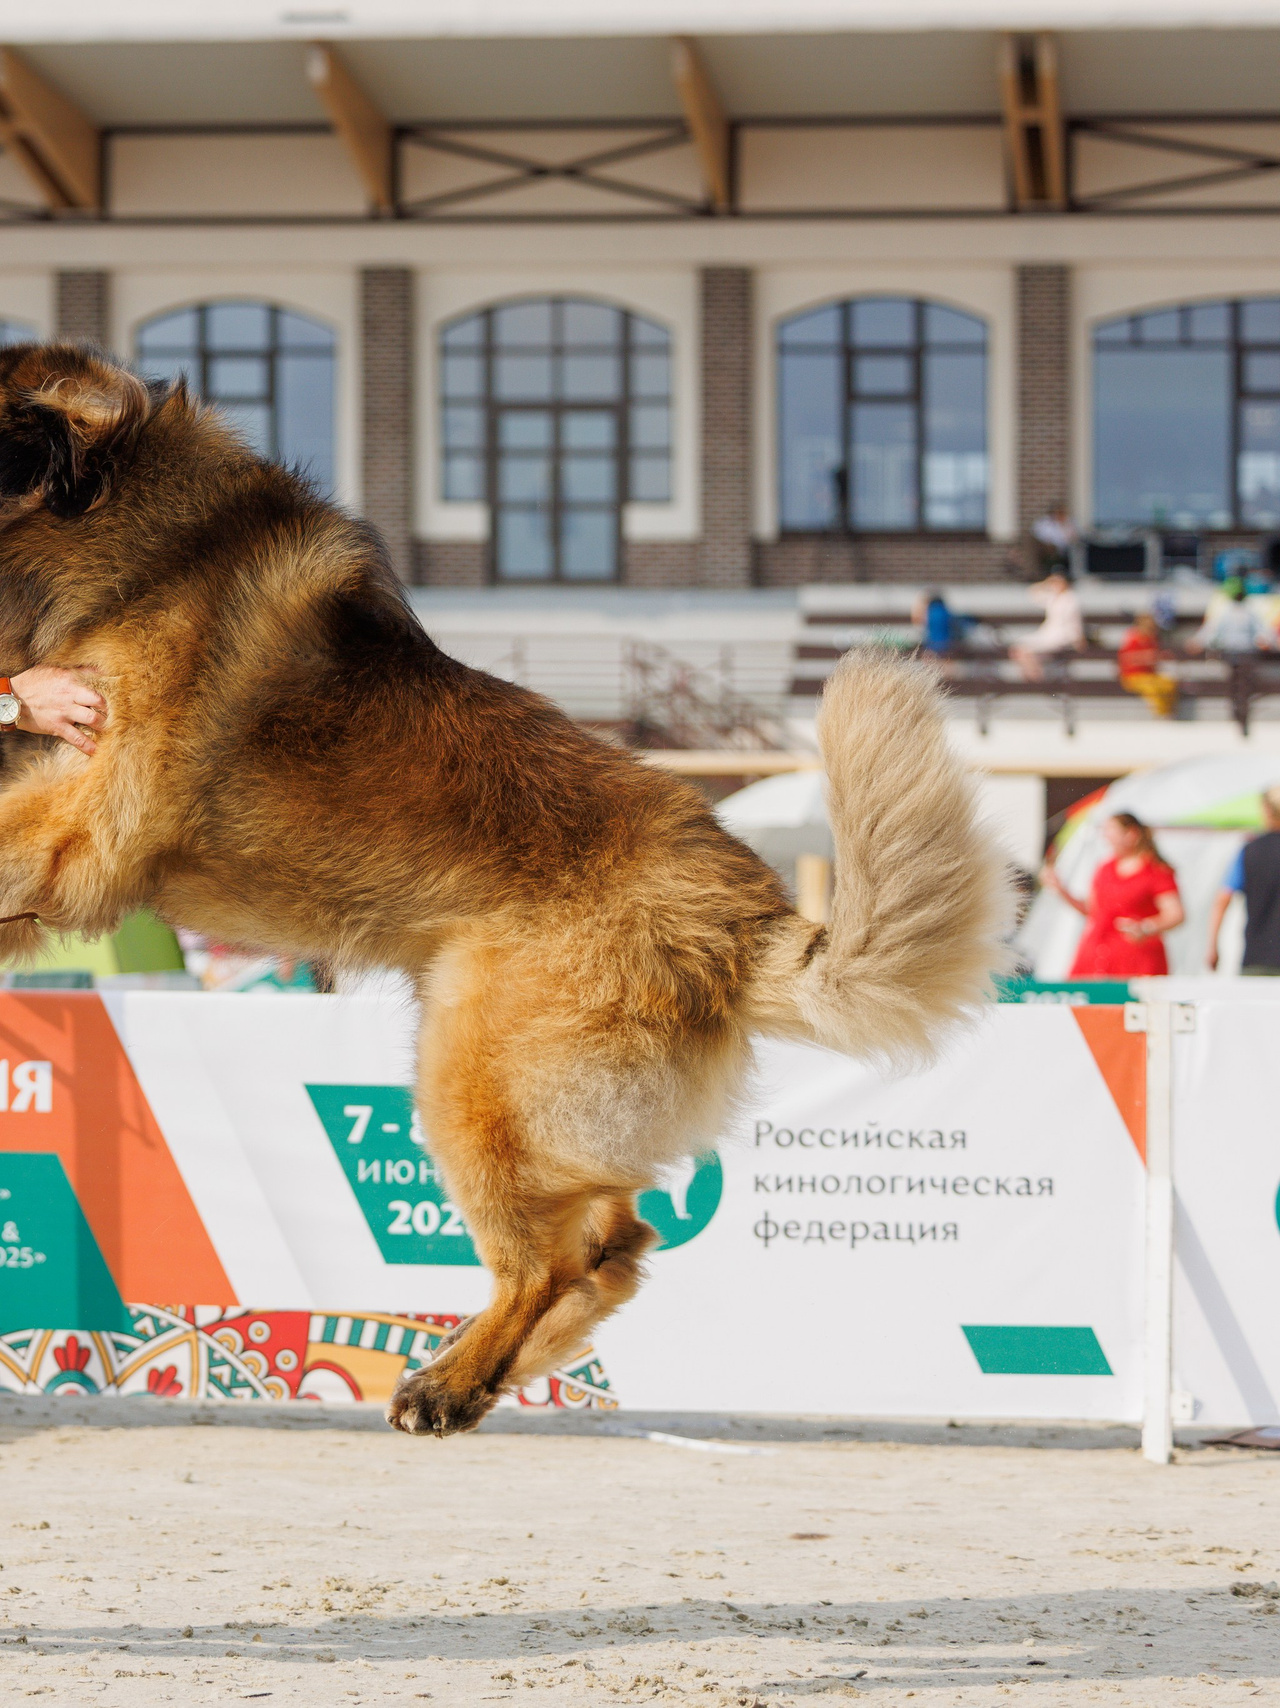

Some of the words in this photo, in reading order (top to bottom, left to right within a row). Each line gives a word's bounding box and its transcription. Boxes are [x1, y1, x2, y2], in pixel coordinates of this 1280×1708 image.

[754, 1119, 968, 1150] Российская
[357, 1158, 442, 1185] ИЮН
[753, 1173, 1056, 1196] кинологическая
[0, 1220, 21, 1243] &
[387, 1199, 469, 1236] 202
[753, 1210, 960, 1250] федерация
